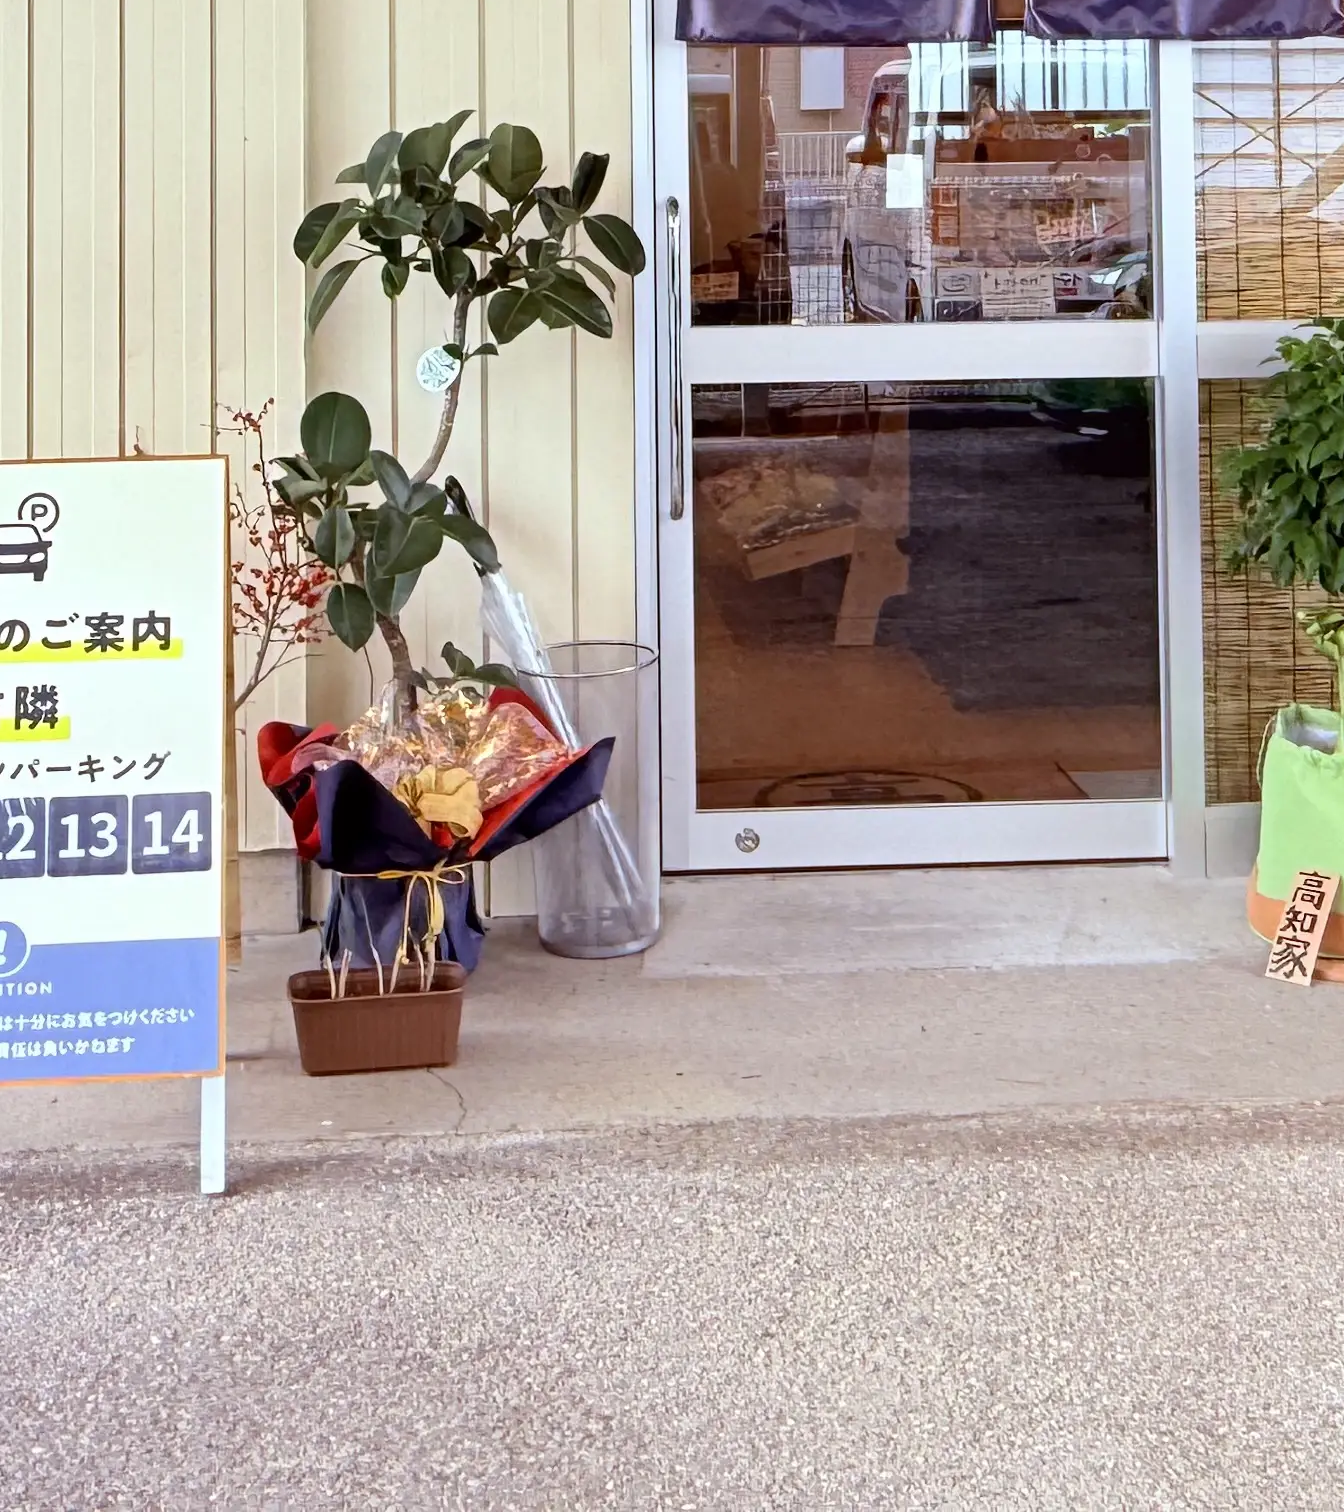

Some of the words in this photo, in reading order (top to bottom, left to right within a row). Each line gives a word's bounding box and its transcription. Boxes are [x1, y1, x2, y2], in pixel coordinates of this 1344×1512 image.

[31, 503, 49, 521] P
[58, 813, 118, 859] 13
[143, 809, 204, 855] 14
[1269, 870, 1331, 979] 高知家
